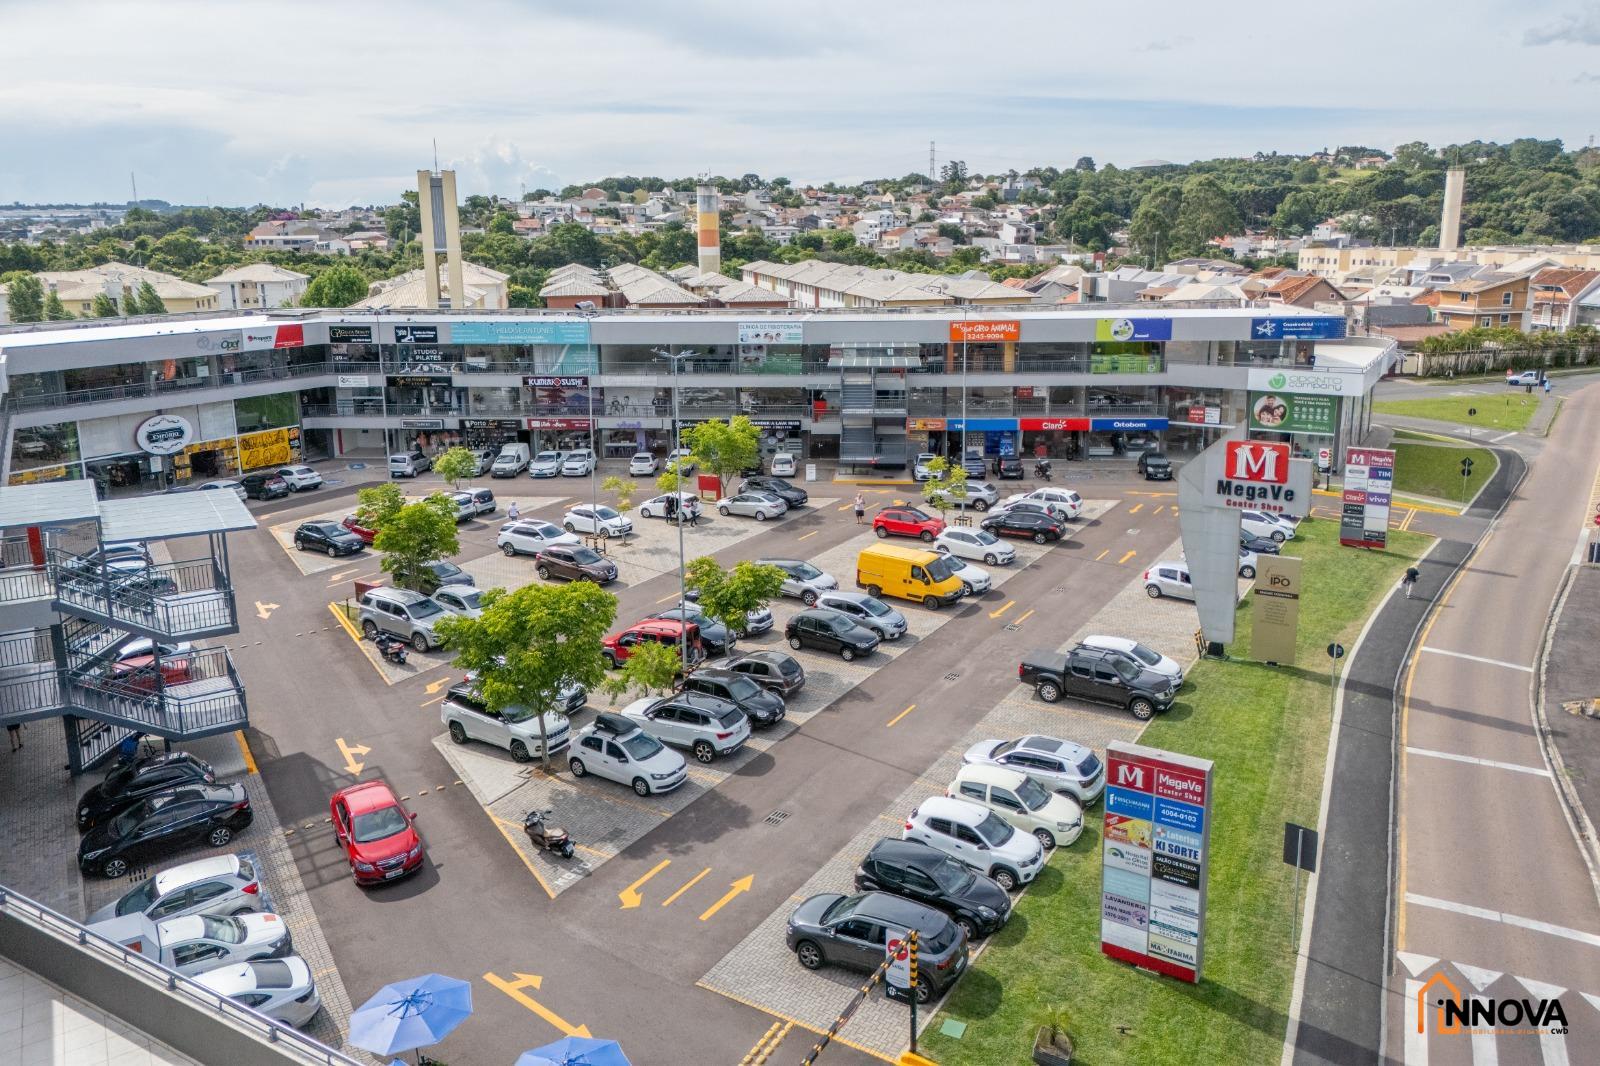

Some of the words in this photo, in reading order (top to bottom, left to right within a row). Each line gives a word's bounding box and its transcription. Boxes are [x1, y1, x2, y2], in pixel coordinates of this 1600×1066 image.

[991, 323, 1017, 332] ANIMAL
[1289, 375, 1342, 385] ODONTO
[1042, 421, 1063, 429] Claro
[1232, 443, 1281, 482] M
[1350, 453, 1365, 464] M
[1377, 470, 1391, 478] TIM
[1216, 479, 1295, 502] MegaVe
[1226, 499, 1258, 510] Center
[1260, 500, 1284, 513] Shop
[1369, 495, 1387, 504] vivo
[1270, 576, 1291, 587] IPO
[1117, 764, 1144, 789] M
[1159, 773, 1202, 792] MegaVe
[1158, 786, 1182, 797] Center
[1184, 792, 1201, 802] Shop
[1161, 808, 1197, 823] 4004-0103
[1155, 840, 1165, 851] KI
[1168, 844, 1200, 860] SORTE
[1105, 895, 1146, 910] LAVANDERIA
